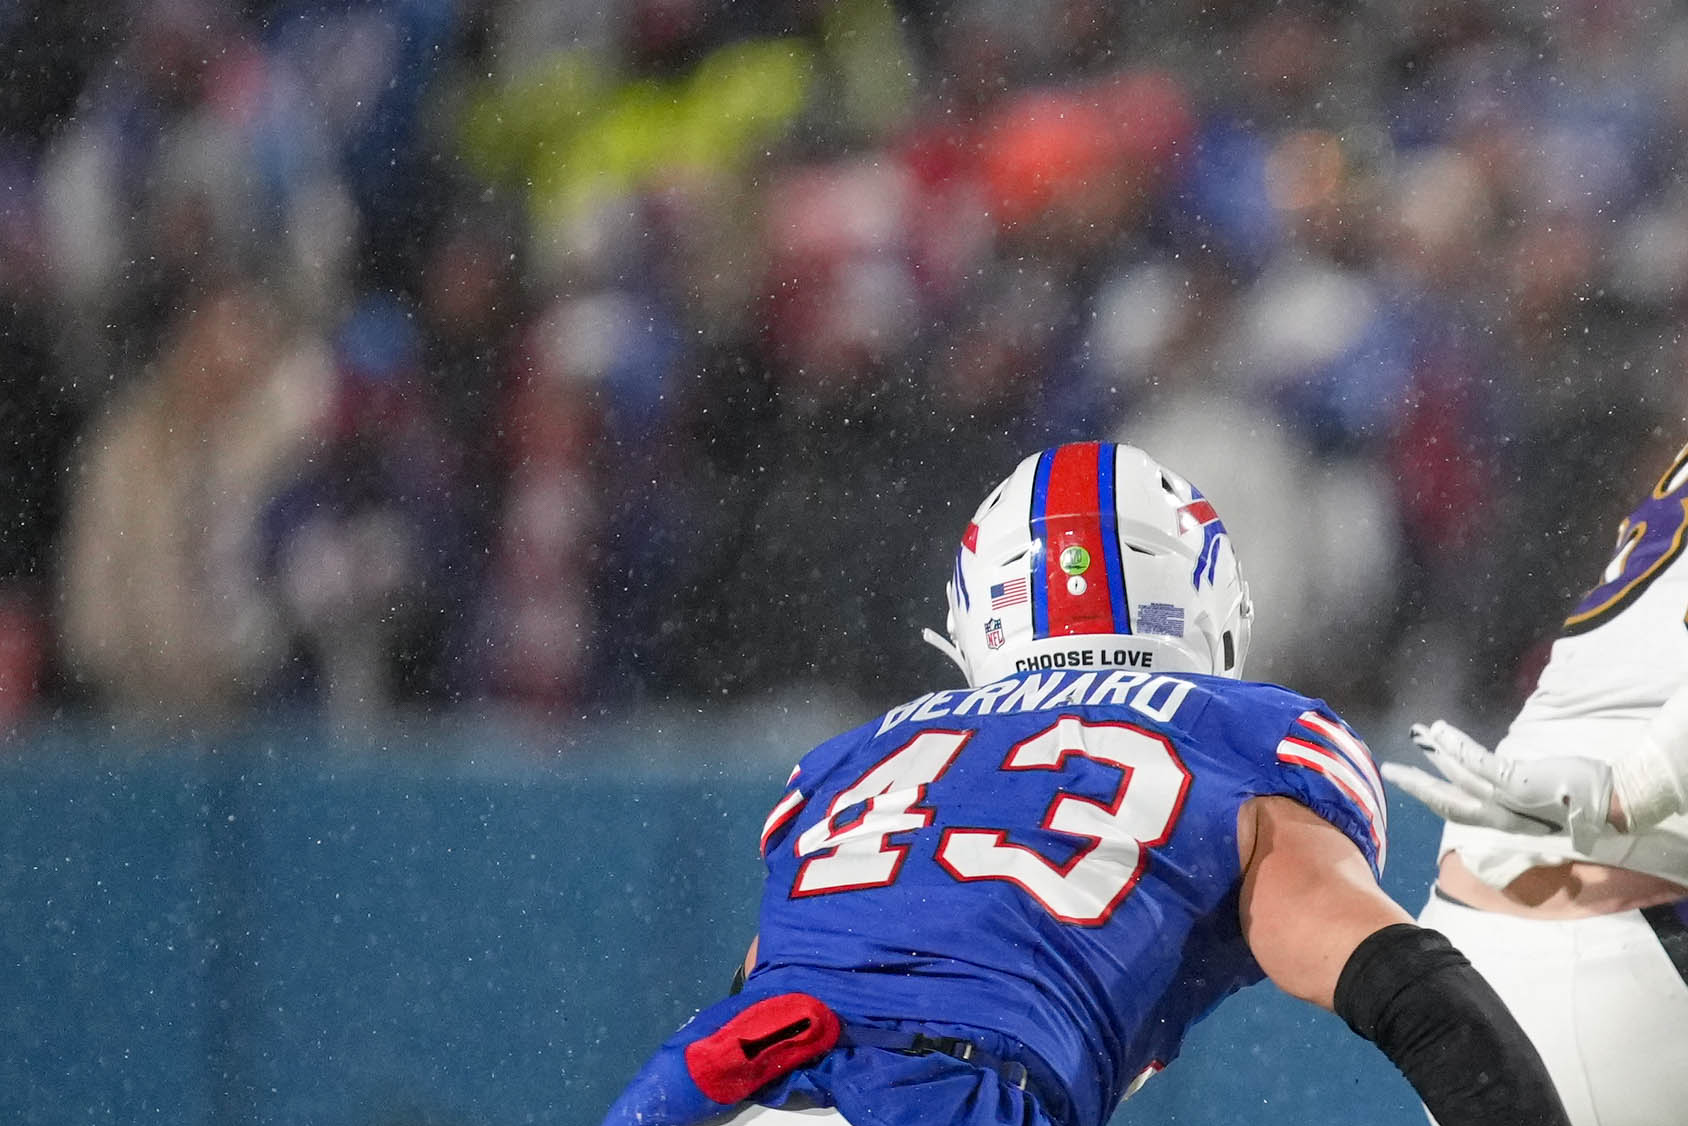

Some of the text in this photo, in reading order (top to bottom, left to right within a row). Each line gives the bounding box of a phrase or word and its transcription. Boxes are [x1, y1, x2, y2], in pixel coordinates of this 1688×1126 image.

[1015, 649, 1154, 673] CHOOSE LOVE
[788, 714, 1195, 929] 43
